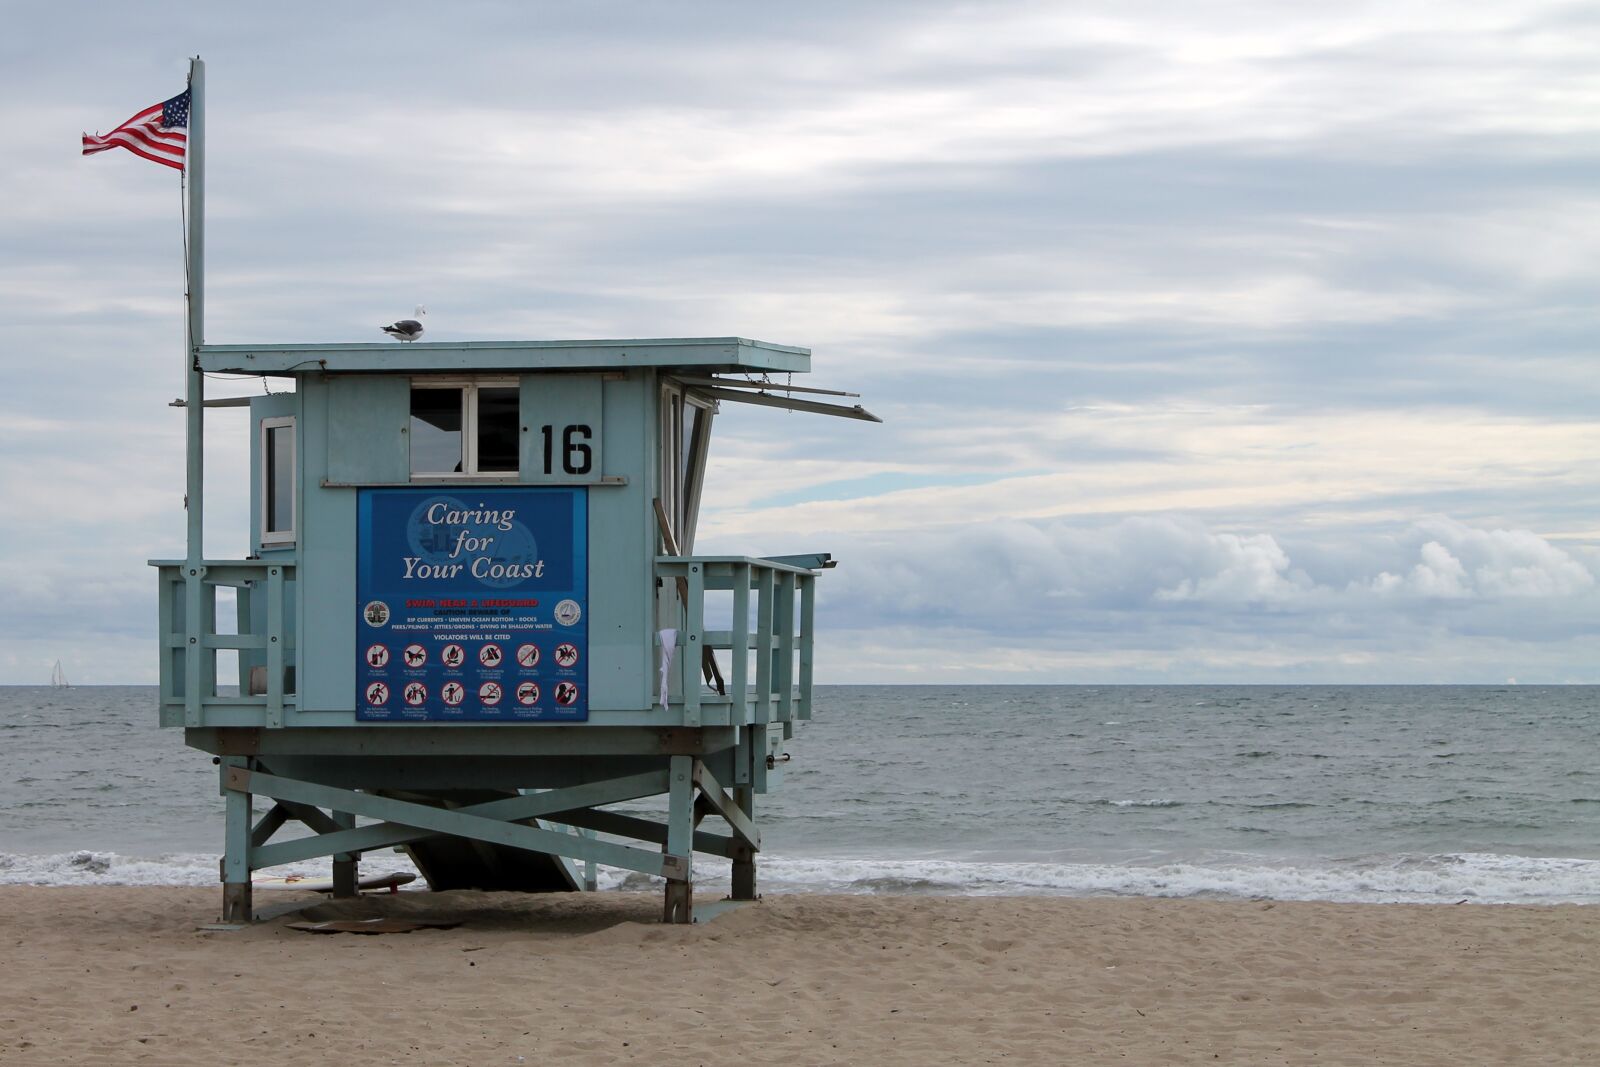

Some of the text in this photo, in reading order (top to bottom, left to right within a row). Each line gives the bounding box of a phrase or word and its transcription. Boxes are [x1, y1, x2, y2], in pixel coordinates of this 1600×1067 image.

[542, 425, 592, 474] 16
[427, 503, 515, 531] Caring
[449, 530, 494, 558] for
[403, 557, 545, 579] Your Coast
[406, 599, 539, 608] SWIM NEAR A LIFEGUARD
